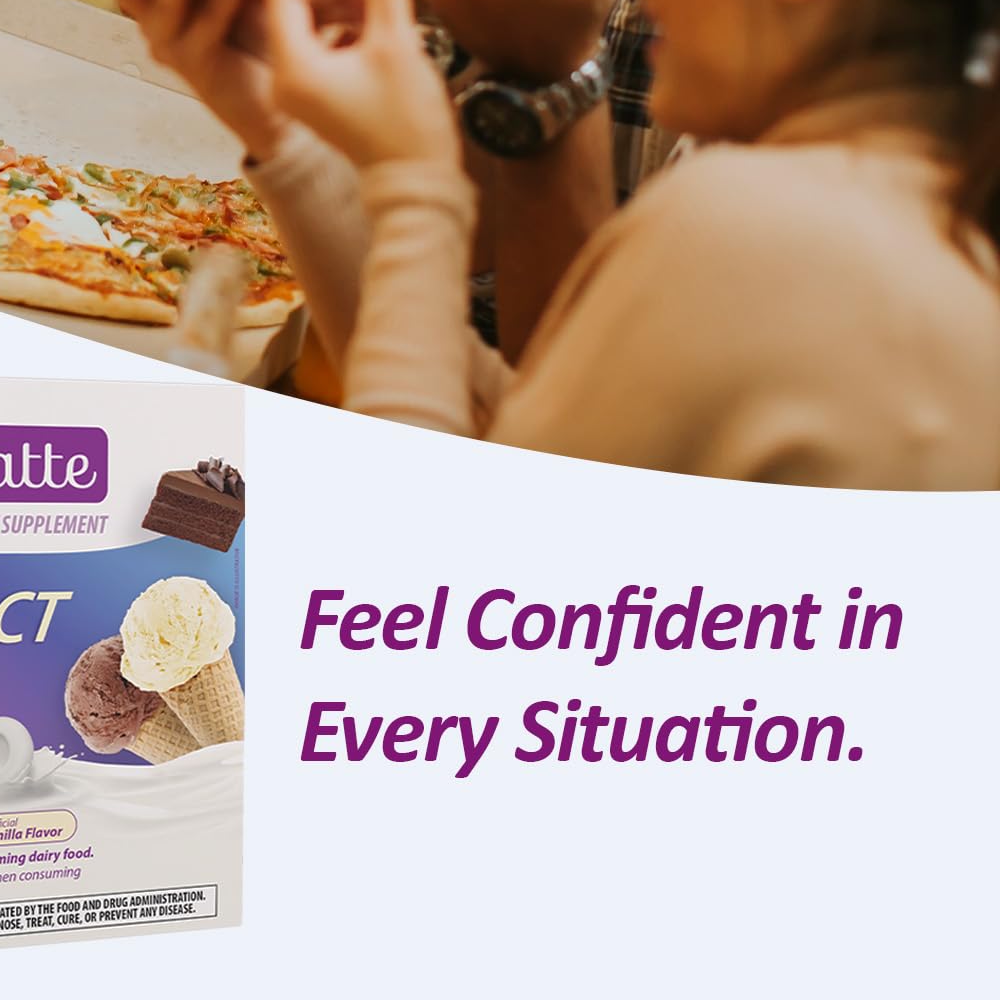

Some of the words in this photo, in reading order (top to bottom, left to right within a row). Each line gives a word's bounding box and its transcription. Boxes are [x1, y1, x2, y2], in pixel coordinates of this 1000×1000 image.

[1, 514, 109, 535] SUPPLEMENT
[24, 826, 64, 840] Flavor
[29, 850, 61, 863] dairy
[63, 846, 94, 860] food.
[19, 866, 81, 882] consuming
[24, 904, 37, 916] BY
[38, 903, 55, 915] THE
[57, 901, 81, 913] FOOD
[82, 899, 102, 911] AND
[103, 896, 129, 909] DRUG
[129, 890, 206, 907] ADMINISTRATION.
[26, 915, 55, 928] TREAT,
[57, 913, 83, 926] CURE,
[84, 912, 97, 923] OR
[99, 908, 138, 922] PREVENT
[139, 907, 158, 919] ANY
[159, 903, 196, 917] DISEASE.
